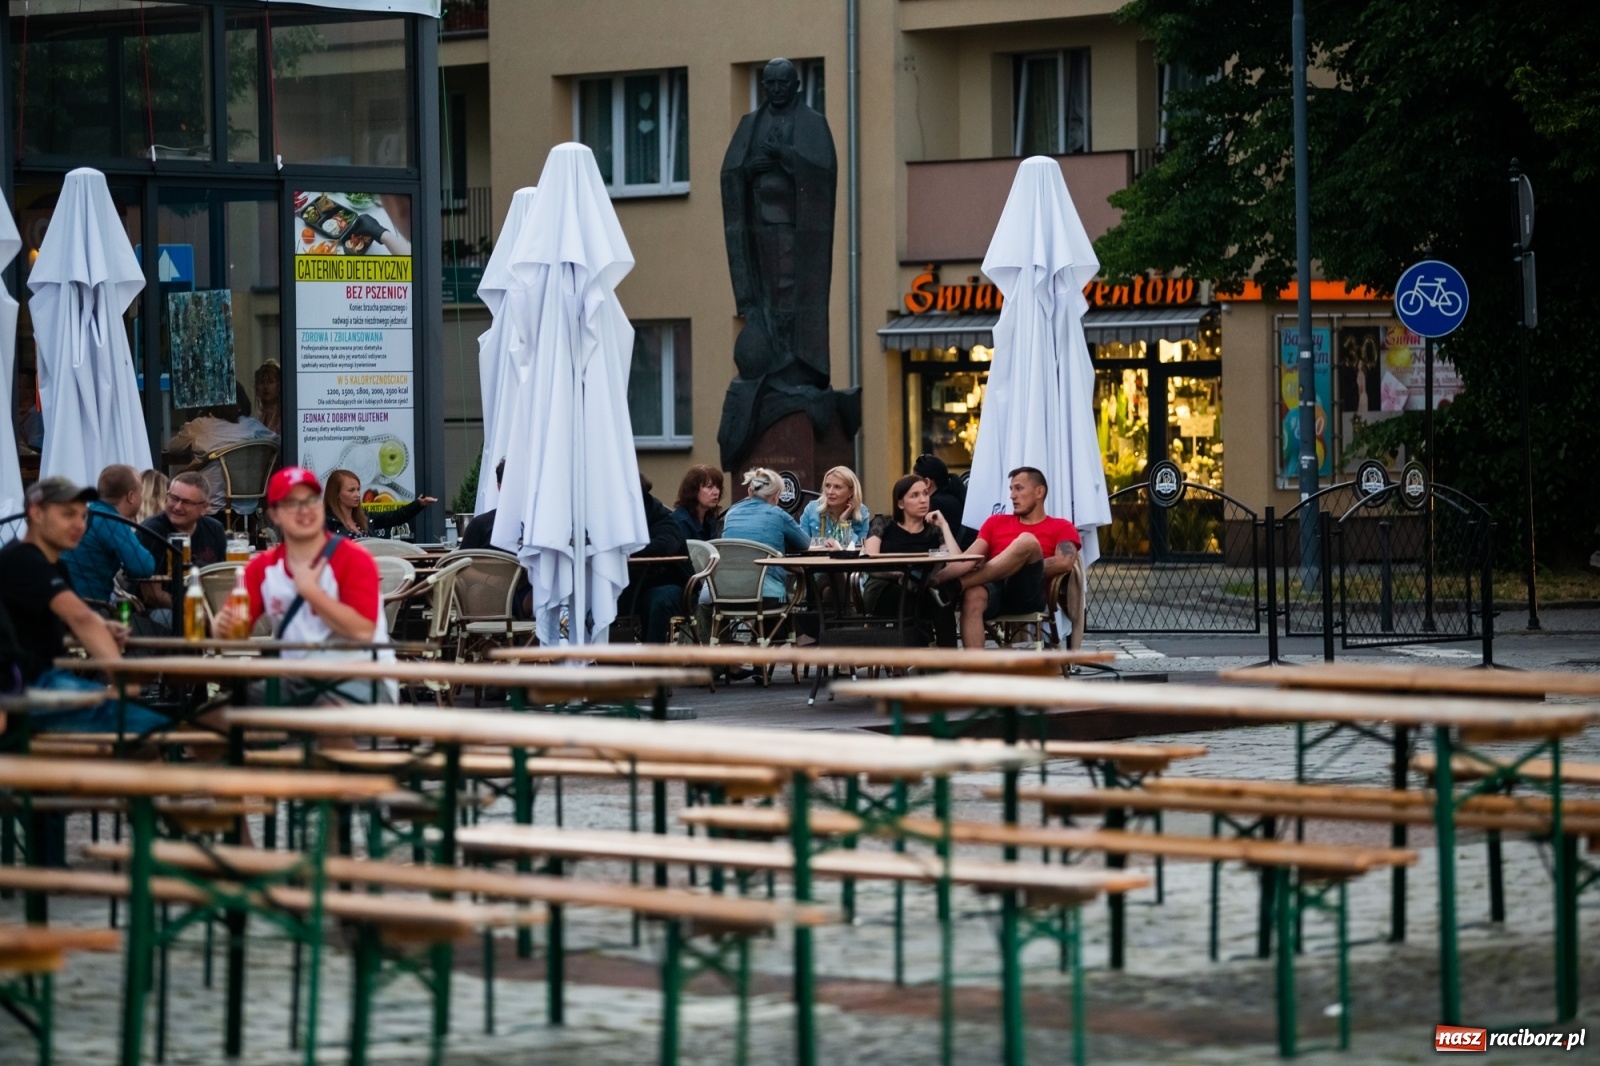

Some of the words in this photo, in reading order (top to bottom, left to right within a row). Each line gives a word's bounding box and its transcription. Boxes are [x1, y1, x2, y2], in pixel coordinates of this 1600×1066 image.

[298, 259, 344, 280] CATERING
[346, 260, 409, 280] DIETETYCZNY
[346, 286, 362, 299] BEZ
[366, 286, 408, 299] PSZENICY
[379, 303, 405, 313] pszenicznego
[332, 316, 349, 327] nadwagi
[301, 332, 328, 342] ZDROWA
[330, 332, 332, 342] I
[335, 332, 383, 342] ZBILANSOWANA
[337, 375, 342, 385] W
[345, 376, 348, 385] 5
[350, 374, 408, 384] KALORYCZNOŚCIACH
[356, 387, 370, 396] 1800,
[303, 413, 325, 423] JEDNAK
[327, 413, 330, 422] Z
[332, 413, 356, 422] DOBRYM
[358, 412, 388, 422] GLUTENEM
